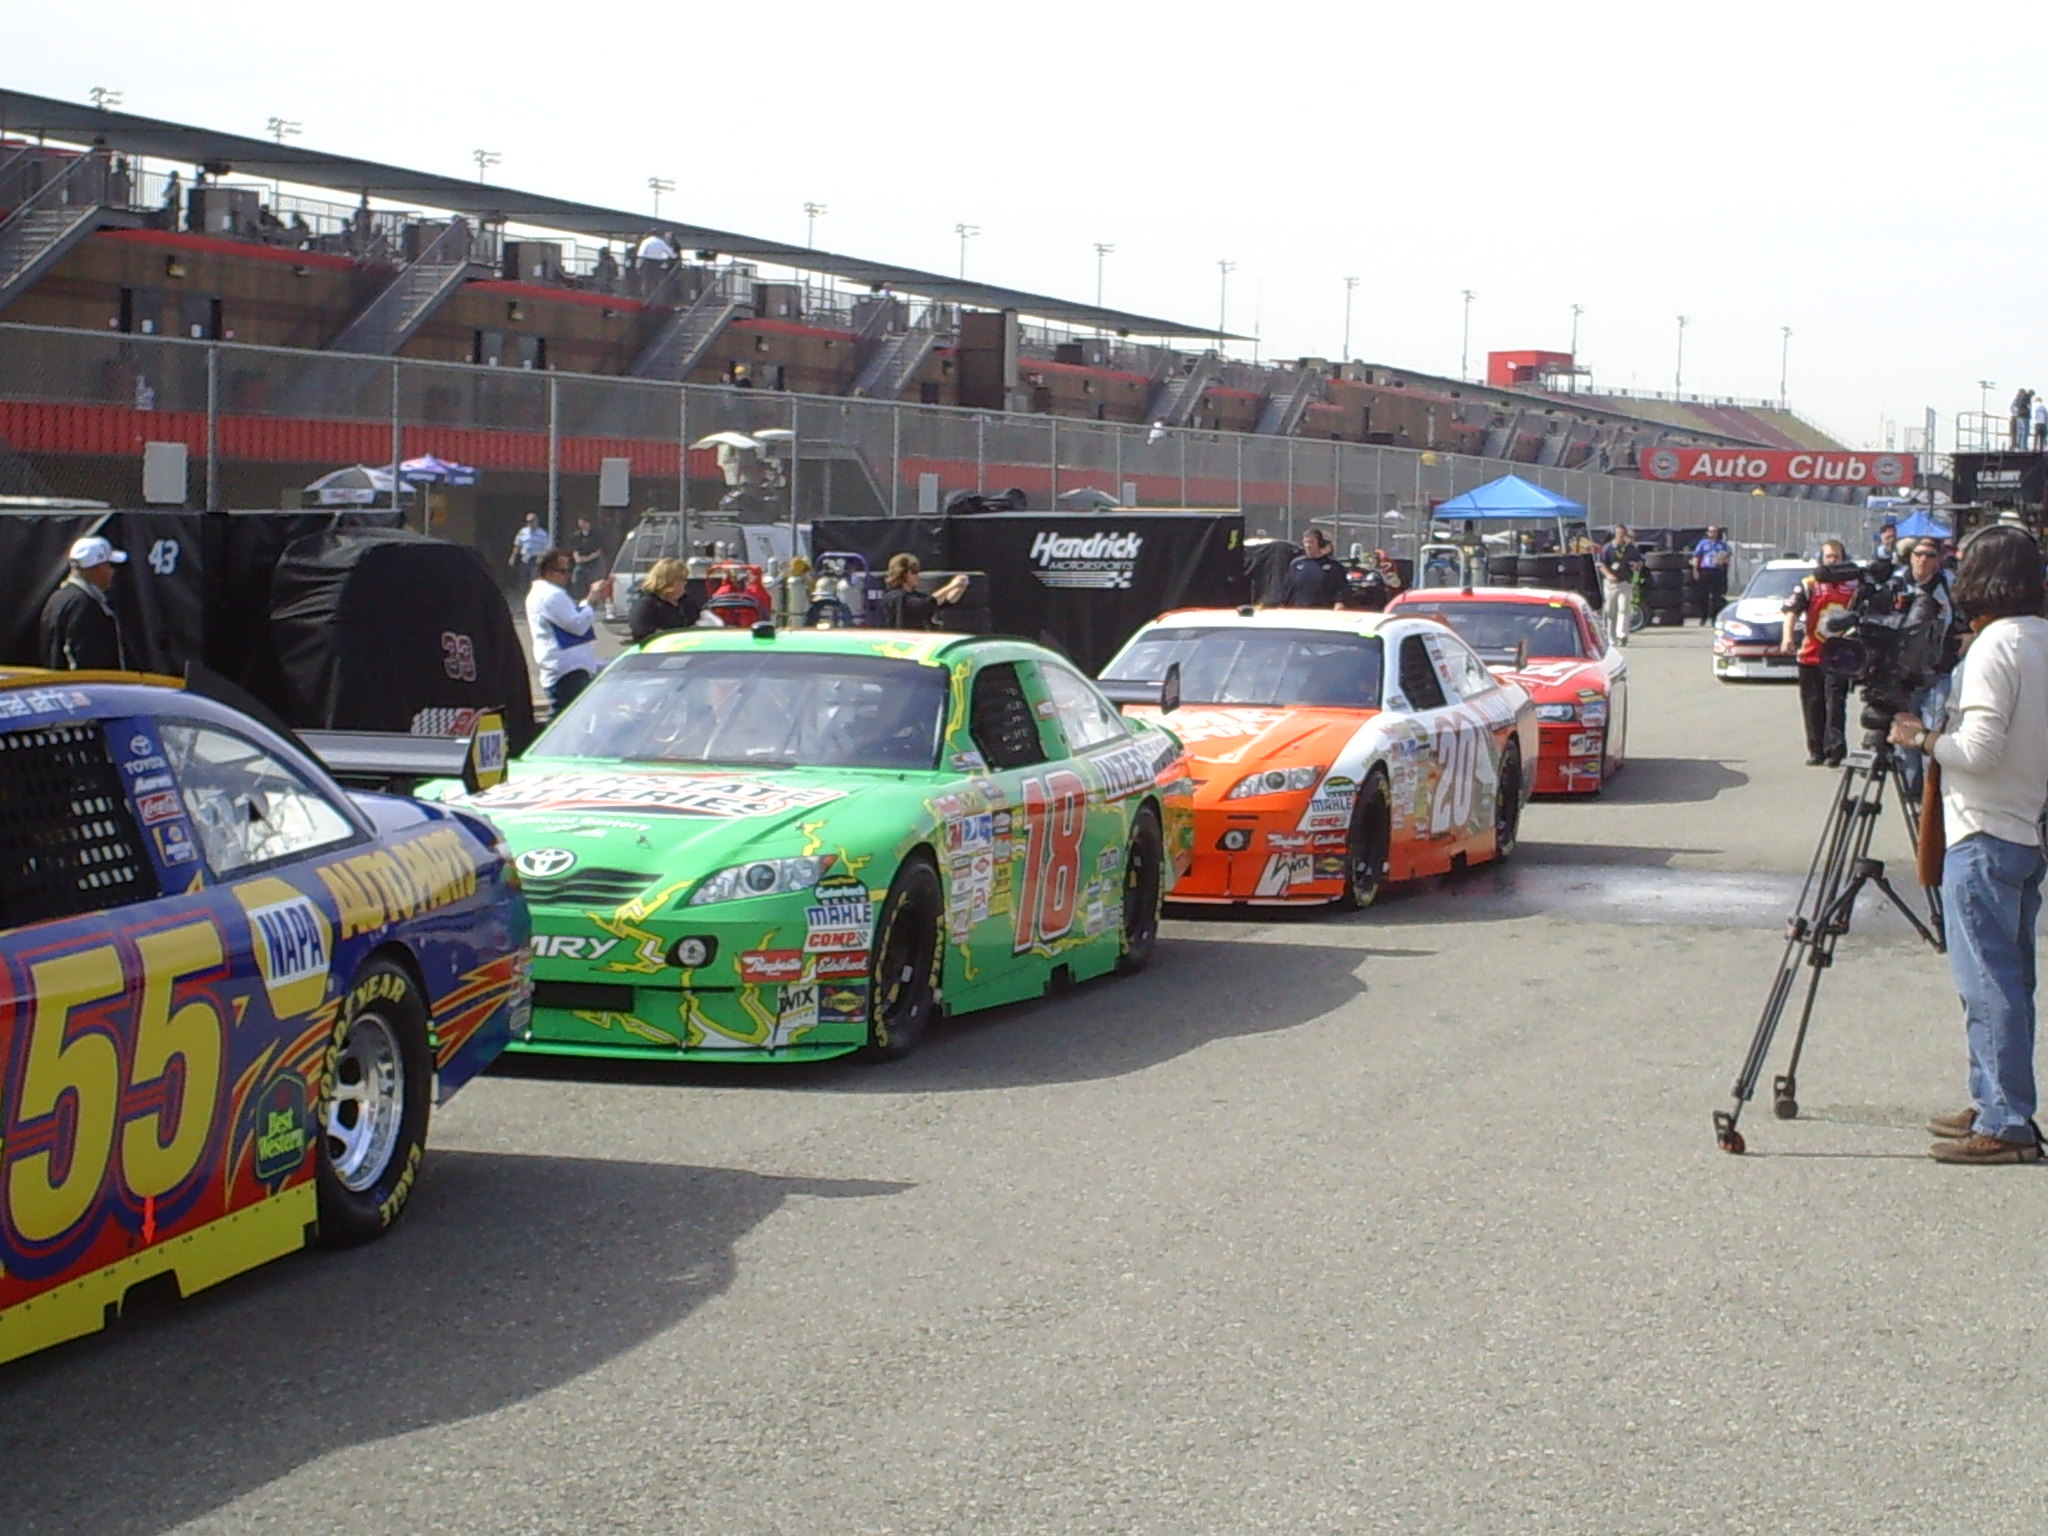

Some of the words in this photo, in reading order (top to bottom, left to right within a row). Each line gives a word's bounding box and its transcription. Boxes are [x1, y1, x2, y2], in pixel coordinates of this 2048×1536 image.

[1690, 453, 1768, 478] Auto
[1789, 455, 1866, 481] Club
[147, 538, 179, 575] 43
[1030, 532, 1143, 566] Hendrick
[1048, 561, 1136, 570] MOTORSPORTS
[441, 631, 476, 682] 33
[1430, 710, 1478, 834] 20
[1013, 769, 1086, 954] 18
[257, 903, 325, 979] NAPA
[316, 850, 414, 939] AUTO
[807, 903, 873, 926] MAHLE
[807, 931, 859, 948] COMP
[9, 921, 224, 1241] 55
[268, 1107, 294, 1138] Best
